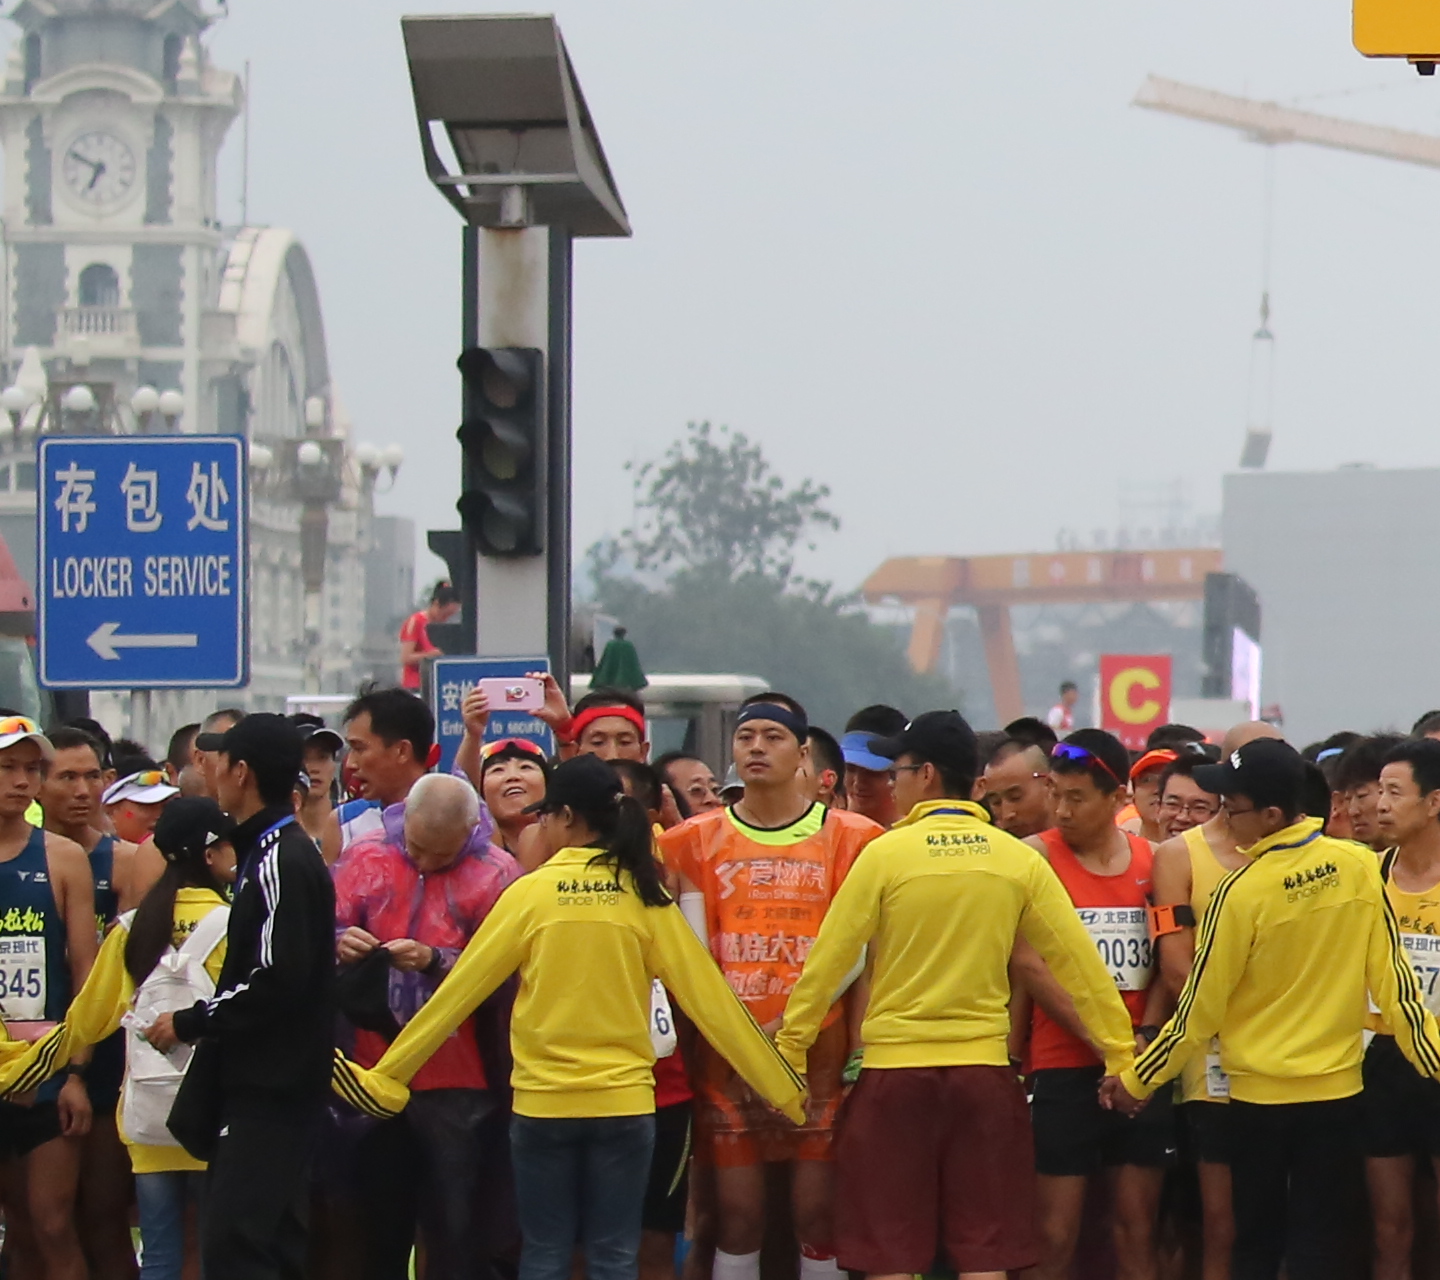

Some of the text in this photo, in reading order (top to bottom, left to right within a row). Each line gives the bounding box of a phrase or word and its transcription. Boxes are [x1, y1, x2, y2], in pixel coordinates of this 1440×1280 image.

[53, 460, 230, 534] 存包处
[52, 554, 231, 599] LOCKER SERVICE
[1108, 666, 1162, 725] C
[492, 720, 503, 734] to
[507, 718, 546, 737] security
[928, 843, 991, 858] since 1981
[557, 893, 620, 907] since 1981
[1286, 873, 1341, 904] since 1981
